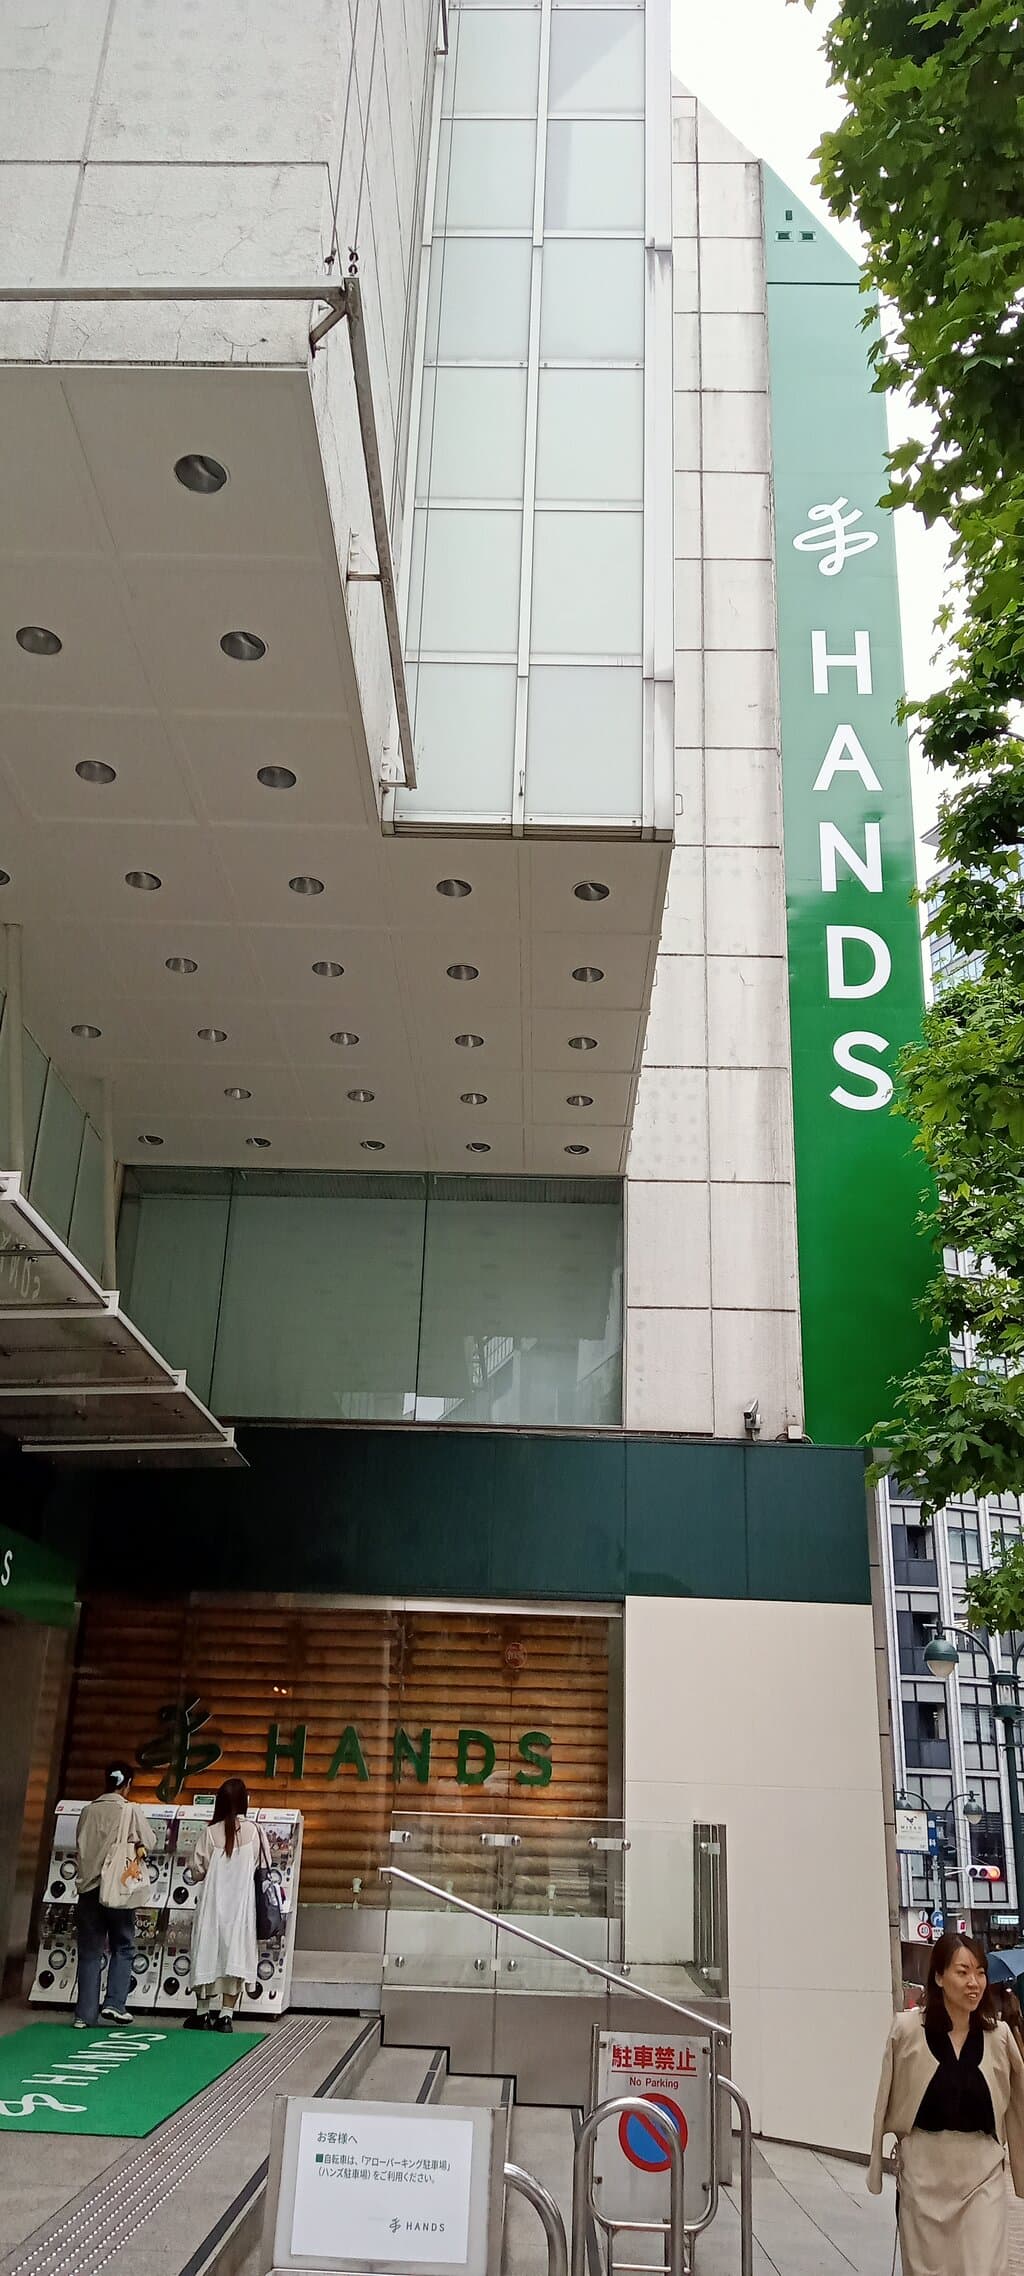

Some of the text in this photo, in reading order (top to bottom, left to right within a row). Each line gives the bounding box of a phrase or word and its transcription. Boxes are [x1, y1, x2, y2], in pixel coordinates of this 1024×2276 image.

[810, 630, 894, 1111] HANDS
[265, 1723, 553, 1788] HANDS
[20, 2031, 168, 2087] HANDS
[611, 2044, 697, 2071] 駐車禁止
[629, 2077, 679, 2090] No Parking
[317, 2131, 358, 2144] お客様へ
[406, 2221, 445, 2232] HANDS
